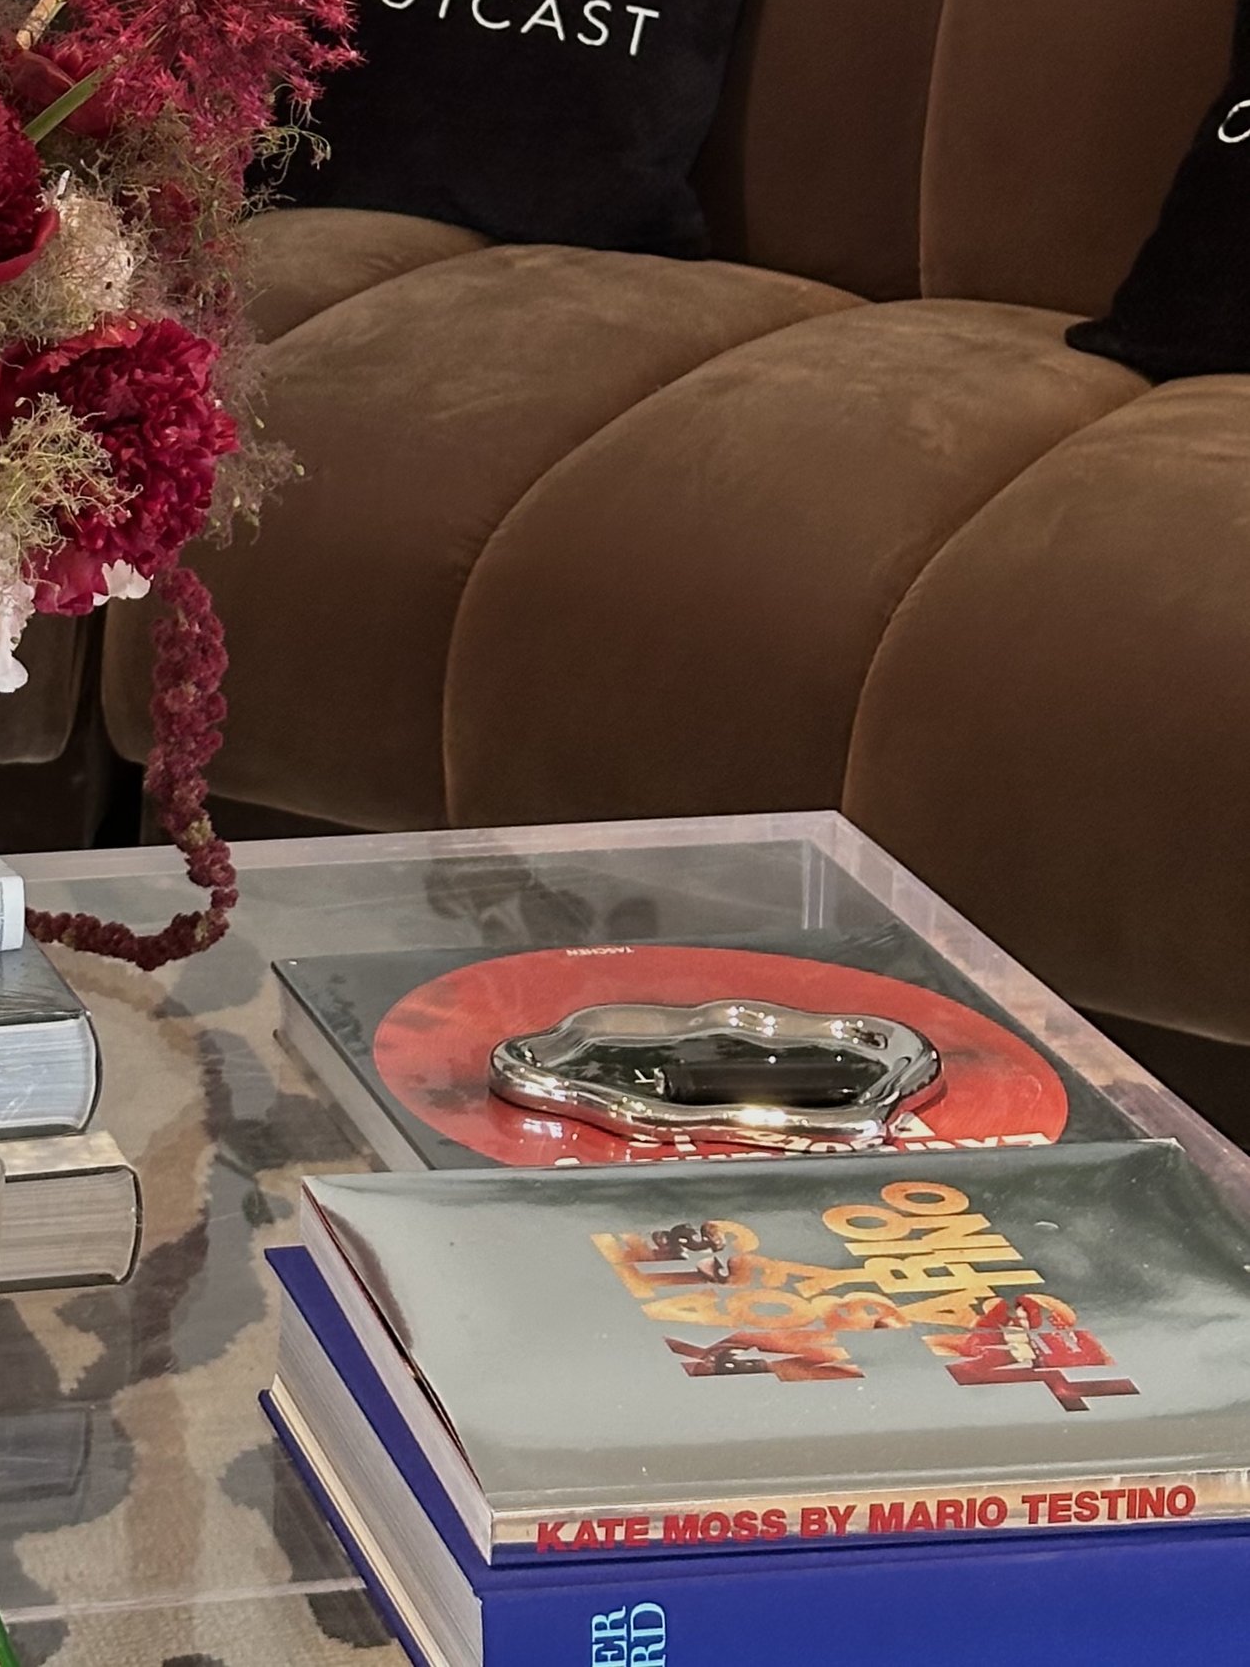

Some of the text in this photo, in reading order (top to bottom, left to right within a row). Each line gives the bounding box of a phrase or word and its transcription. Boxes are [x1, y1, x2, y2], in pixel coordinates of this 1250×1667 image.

[536, 1485, 1196, 1554] KATE MOSS BY MARIO TESTINO
